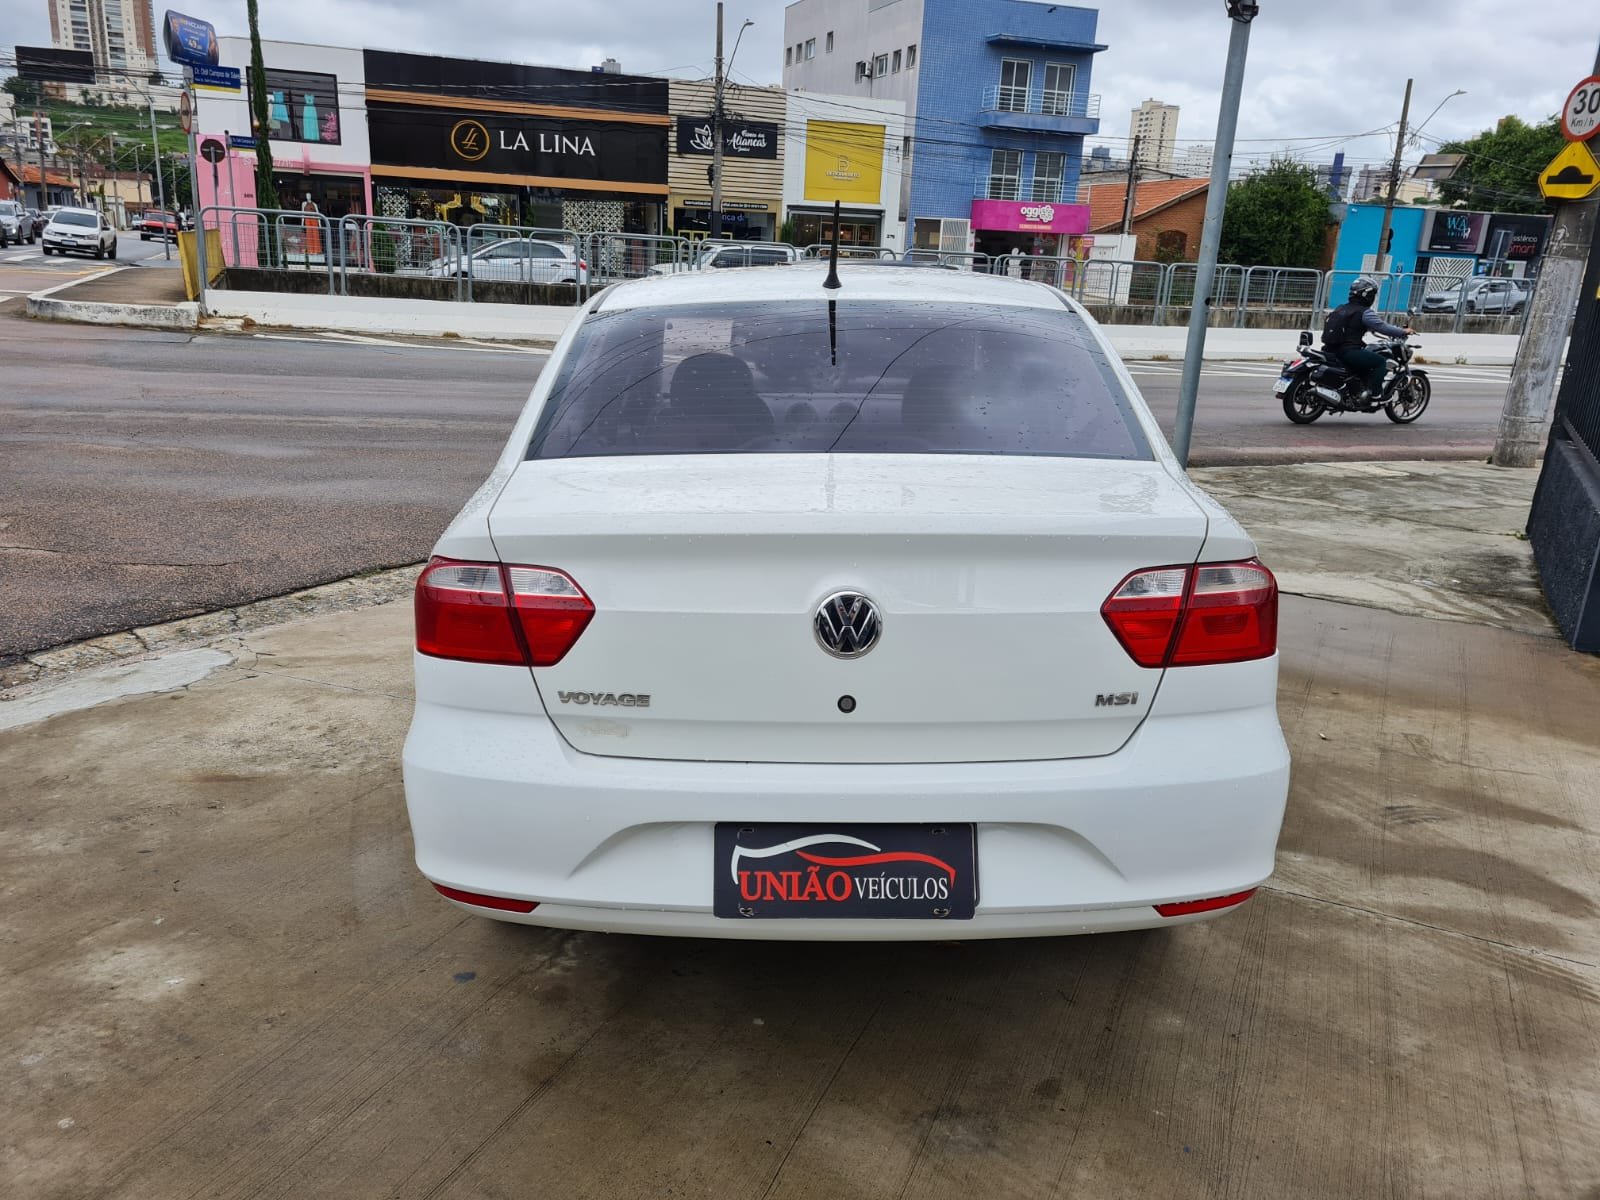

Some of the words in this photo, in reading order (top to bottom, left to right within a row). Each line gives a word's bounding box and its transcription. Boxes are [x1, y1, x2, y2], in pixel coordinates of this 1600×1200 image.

[1573, 87, 1600, 114] 30
[499, 130, 530, 151] LA
[539, 133, 596, 156] LINA
[1020, 205, 1041, 218] oggi
[557, 690, 651, 707] VOYAGE
[738, 865, 853, 902] UNIÃO
[854, 871, 949, 901] VEÍCULOS
